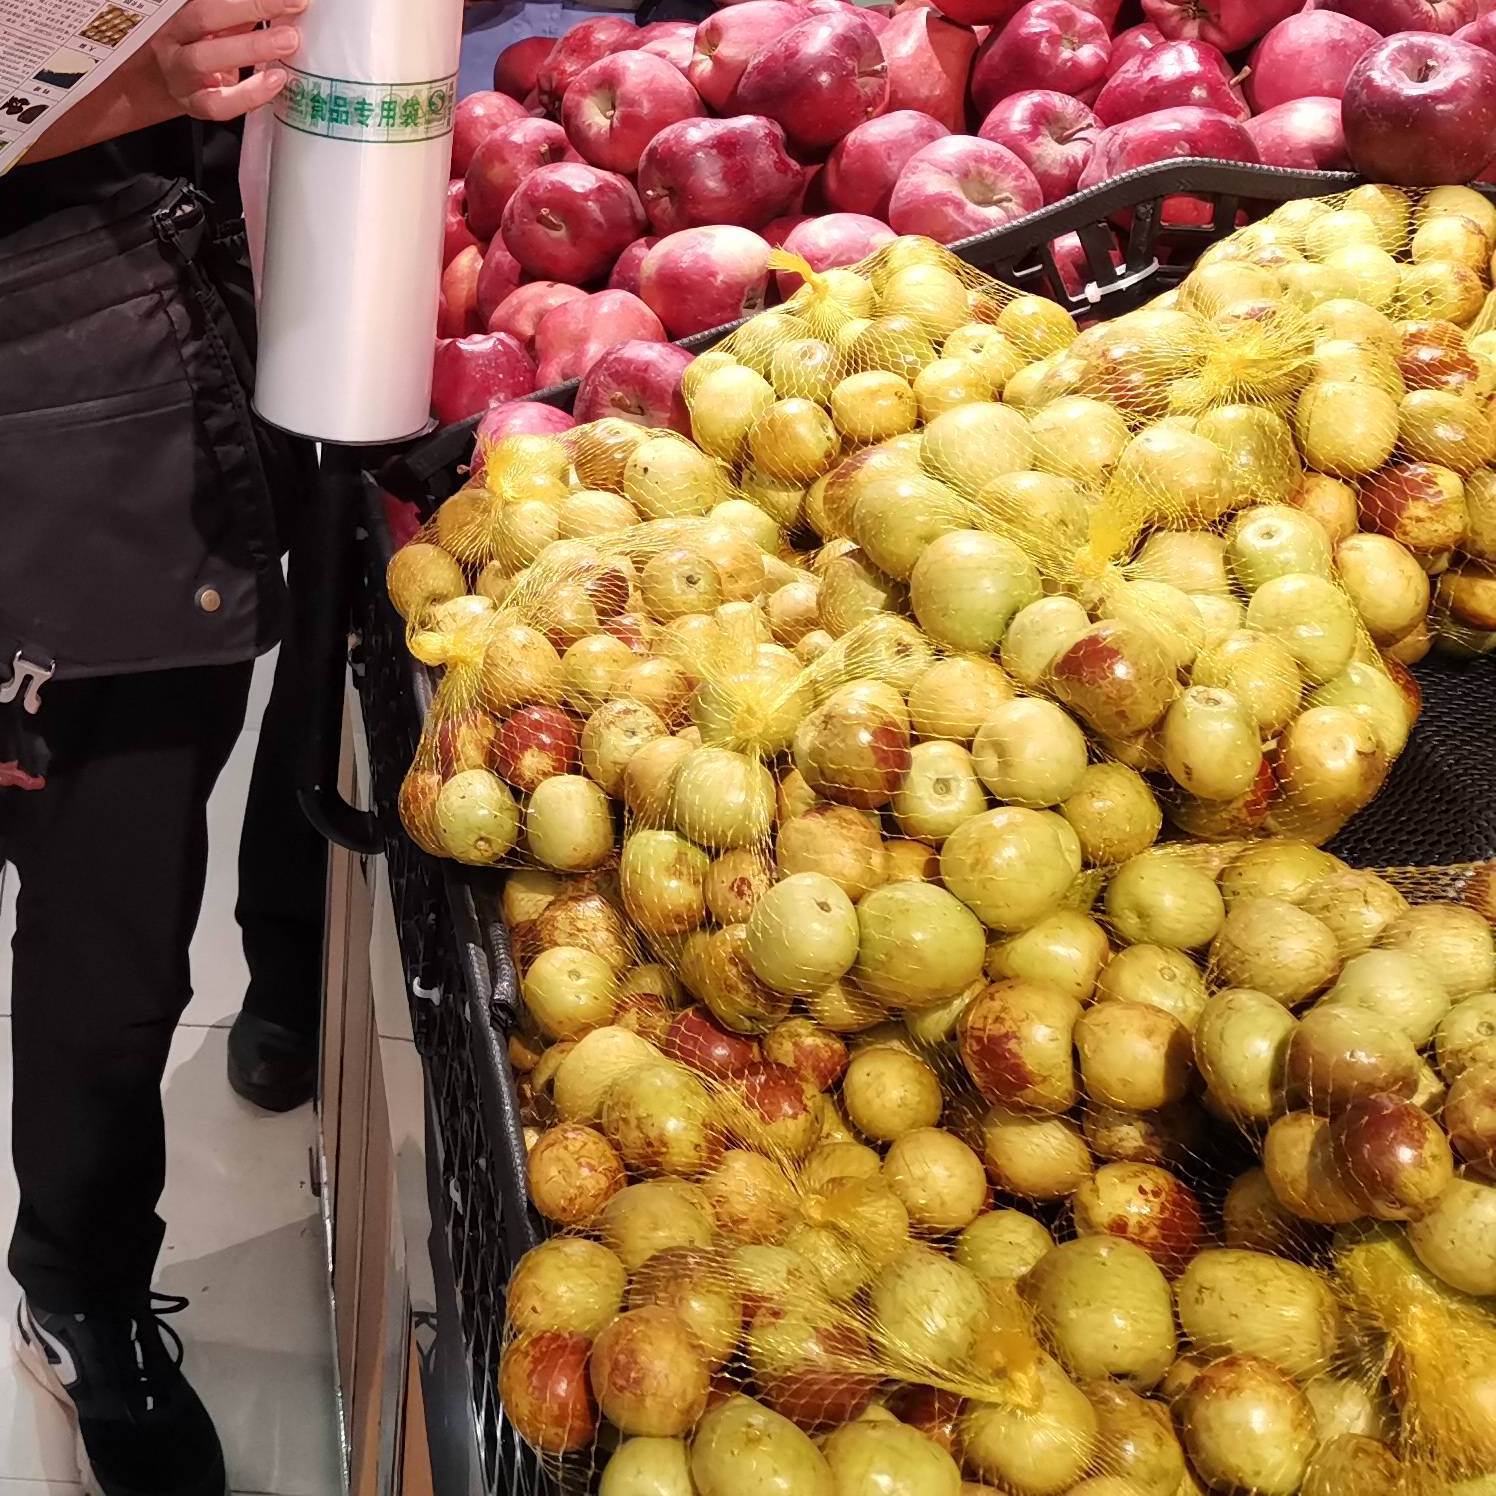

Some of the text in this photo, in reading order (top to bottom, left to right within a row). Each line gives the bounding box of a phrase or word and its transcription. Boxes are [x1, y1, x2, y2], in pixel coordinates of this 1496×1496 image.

[309, 90, 422, 129] 食品专用袋
